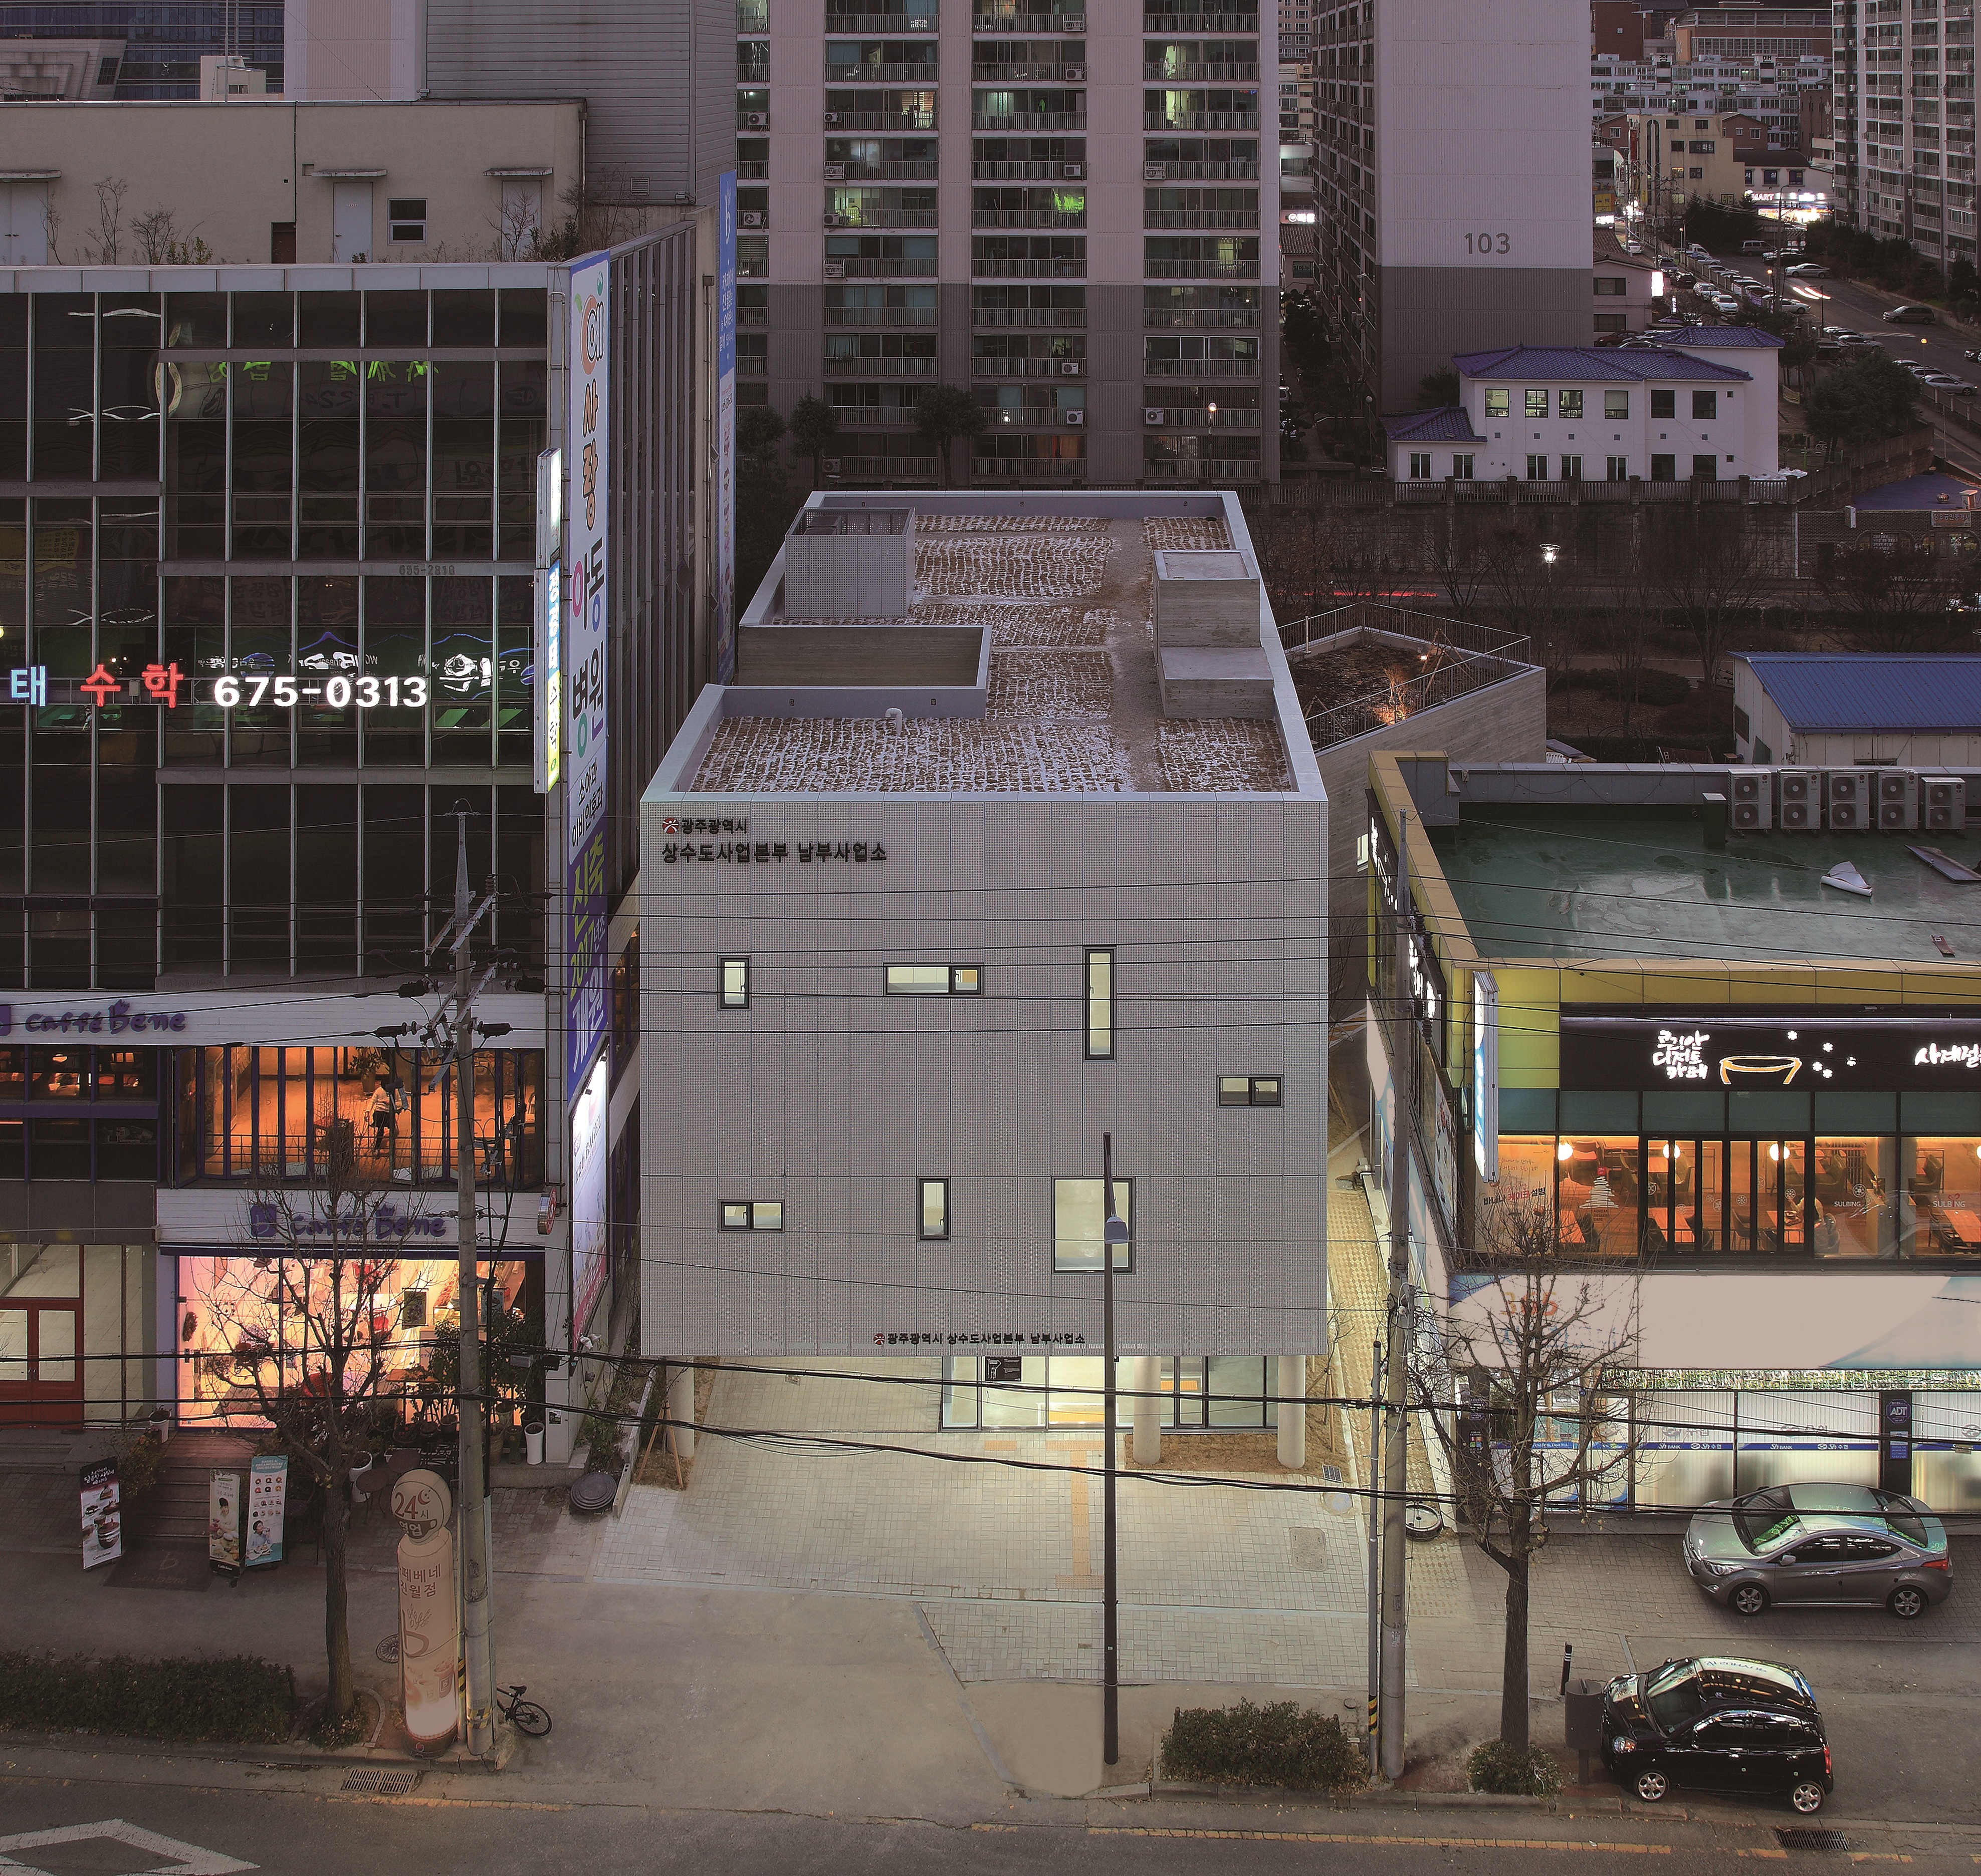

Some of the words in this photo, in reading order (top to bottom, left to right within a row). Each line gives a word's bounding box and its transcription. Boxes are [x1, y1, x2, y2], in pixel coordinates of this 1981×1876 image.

[1464, 233, 1510, 255] 103
[10, 664, 47, 708] 태
[80, 663, 185, 709] 수학
[214, 675, 427, 708] 675-0313
[572, 640, 604, 758] 병원
[577, 757, 598, 806] 소아과
[571, 781, 603, 847] 이비인후과
[682, 818, 747, 834] 광주광역시
[662, 840, 789, 863] 상수도사업본부
[798, 840, 887, 863] 남부사업소
[1657, 1030, 1710, 1051] 코리안
[1652, 1048, 1703, 1066] 디저트
[1666, 1062, 1709, 1080] 카페
[585, 1115, 603, 1161] BAGEL
[1530, 1187, 1546, 1198] 설빙
[888, 1332, 943, 1345] 광주광역시
[948, 1332, 1025, 1345] 상수도사업본부
[1030, 1332, 1086, 1345] 남부사업소
[1890, 1406, 1908, 1417] ADT
[399, 1521, 422, 1536] 영업
[399, 1563, 442, 1583] 페베네
[400, 1581, 437, 1599] 진월점
